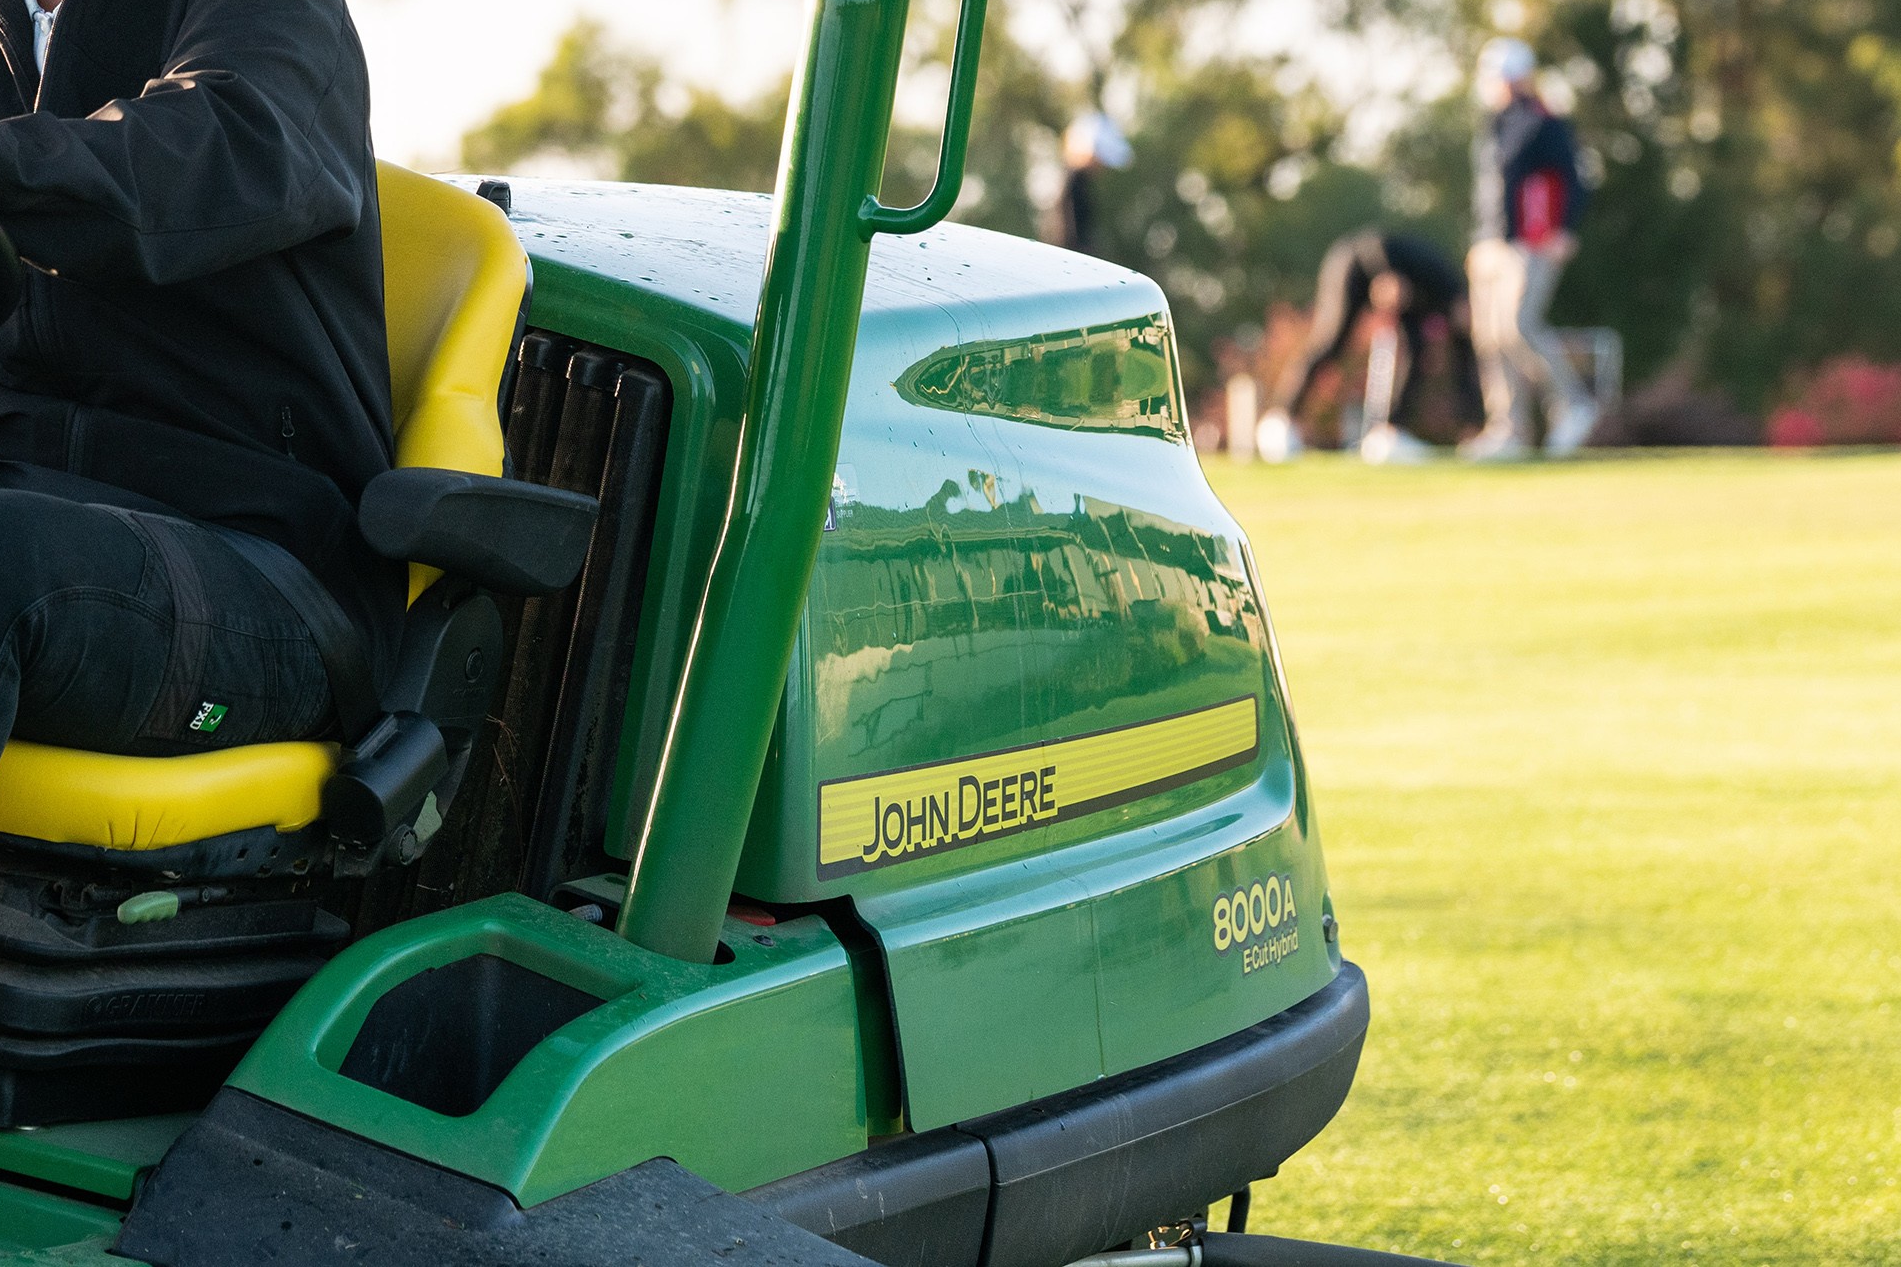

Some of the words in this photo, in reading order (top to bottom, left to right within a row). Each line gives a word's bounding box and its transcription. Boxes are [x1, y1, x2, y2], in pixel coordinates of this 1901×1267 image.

[189, 701, 214, 730] FXD
[863, 790, 950, 857] JOHN
[958, 765, 1057, 829] DEERE
[1269, 926, 1299, 964] Hybrid
